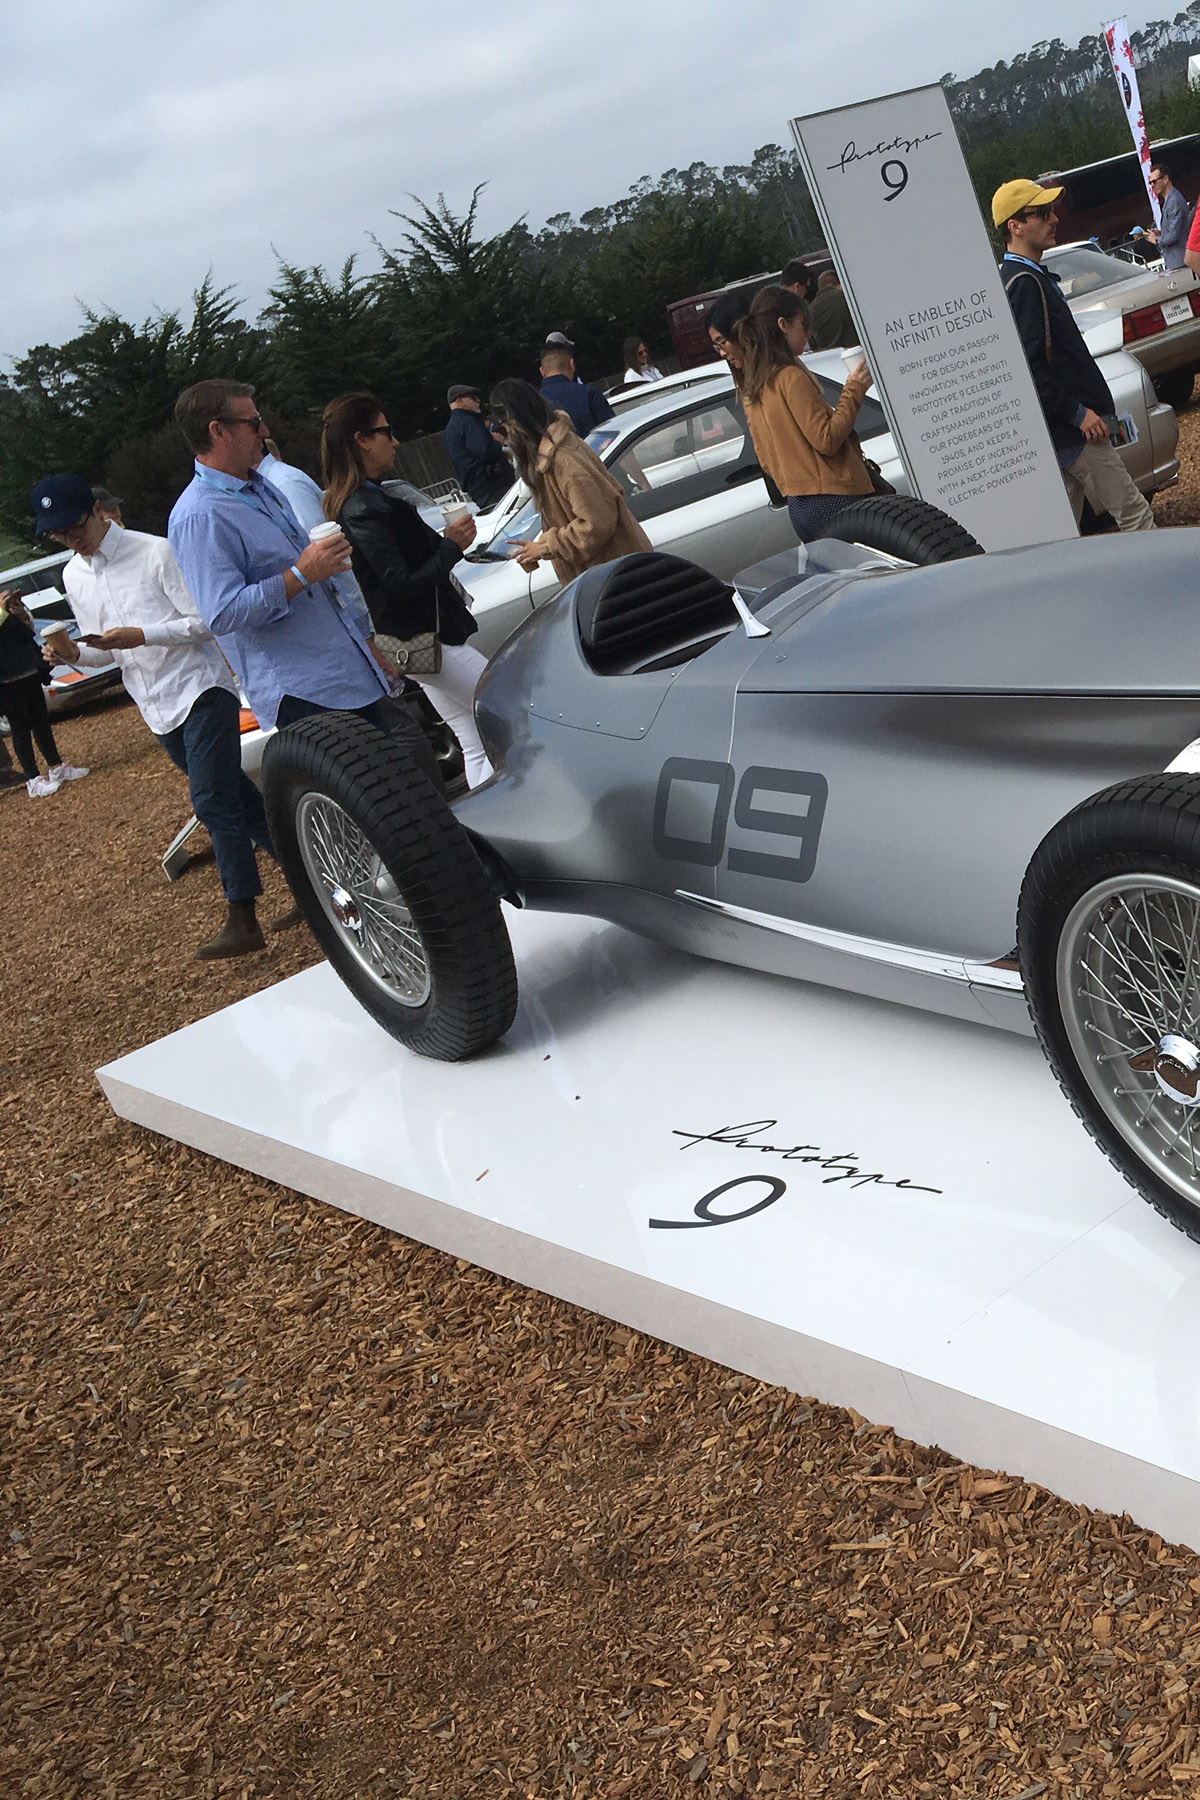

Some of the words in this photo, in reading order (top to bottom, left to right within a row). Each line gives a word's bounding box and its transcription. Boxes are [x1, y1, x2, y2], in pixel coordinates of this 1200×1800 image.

[827, 131, 942, 173] Prototype
[880, 159, 908, 201] 9
[885, 318, 904, 335] AN
[909, 298, 966, 328] EMBLEM
[970, 290, 988, 305] OF
[891, 327, 941, 352] INFINITI
[945, 307, 995, 333] DESIGN.
[900, 361, 922, 375] BORN
[924, 352, 948, 367] FROM
[949, 346, 966, 357] OUR
[967, 333, 1000, 351] PASSION
[922, 370, 937, 381] FOR
[940, 359, 968, 376] DESIGN
[970, 353, 987, 365] AND
[960, 372, 976, 383] THE
[977, 360, 1008, 378] INFINITI
[912, 390, 958, 415] PROTOTYPE
[960, 389, 965, 398] 9
[966, 373, 1013, 395] CELEBRATES
[932, 410, 948, 423] OUR
[949, 395, 990, 416] TRADITION
[992, 391, 1002, 401] OF
[987, 404, 1009, 417] NODS
[1009, 399, 1021, 409] TO
[929, 441, 946, 453] OUR
[948, 425, 993, 447] FOREBEARS
[994, 419, 1003, 430] OF
[1005, 413, 1021, 424] THE
[968, 443, 984, 453] AND
[987, 432, 1011, 446] KEEPS
[1013, 429, 1019, 437] A
[937, 482, 958, 495] WITH
[960, 478, 966, 486] A
[967, 450, 1037, 484] NEXT-GENERATION
[938, 461, 974, 480] PROMISE
[975, 454, 985, 465] OF
[988, 438, 1029, 461] INGENUITY
[949, 485, 985, 506] ELECTRIC
[987, 465, 1036, 490] POWERTRAIN
[653, 756, 828, 883] 09
[672, 1119, 943, 1194] Prototype
[649, 1174, 787, 1229] 9
